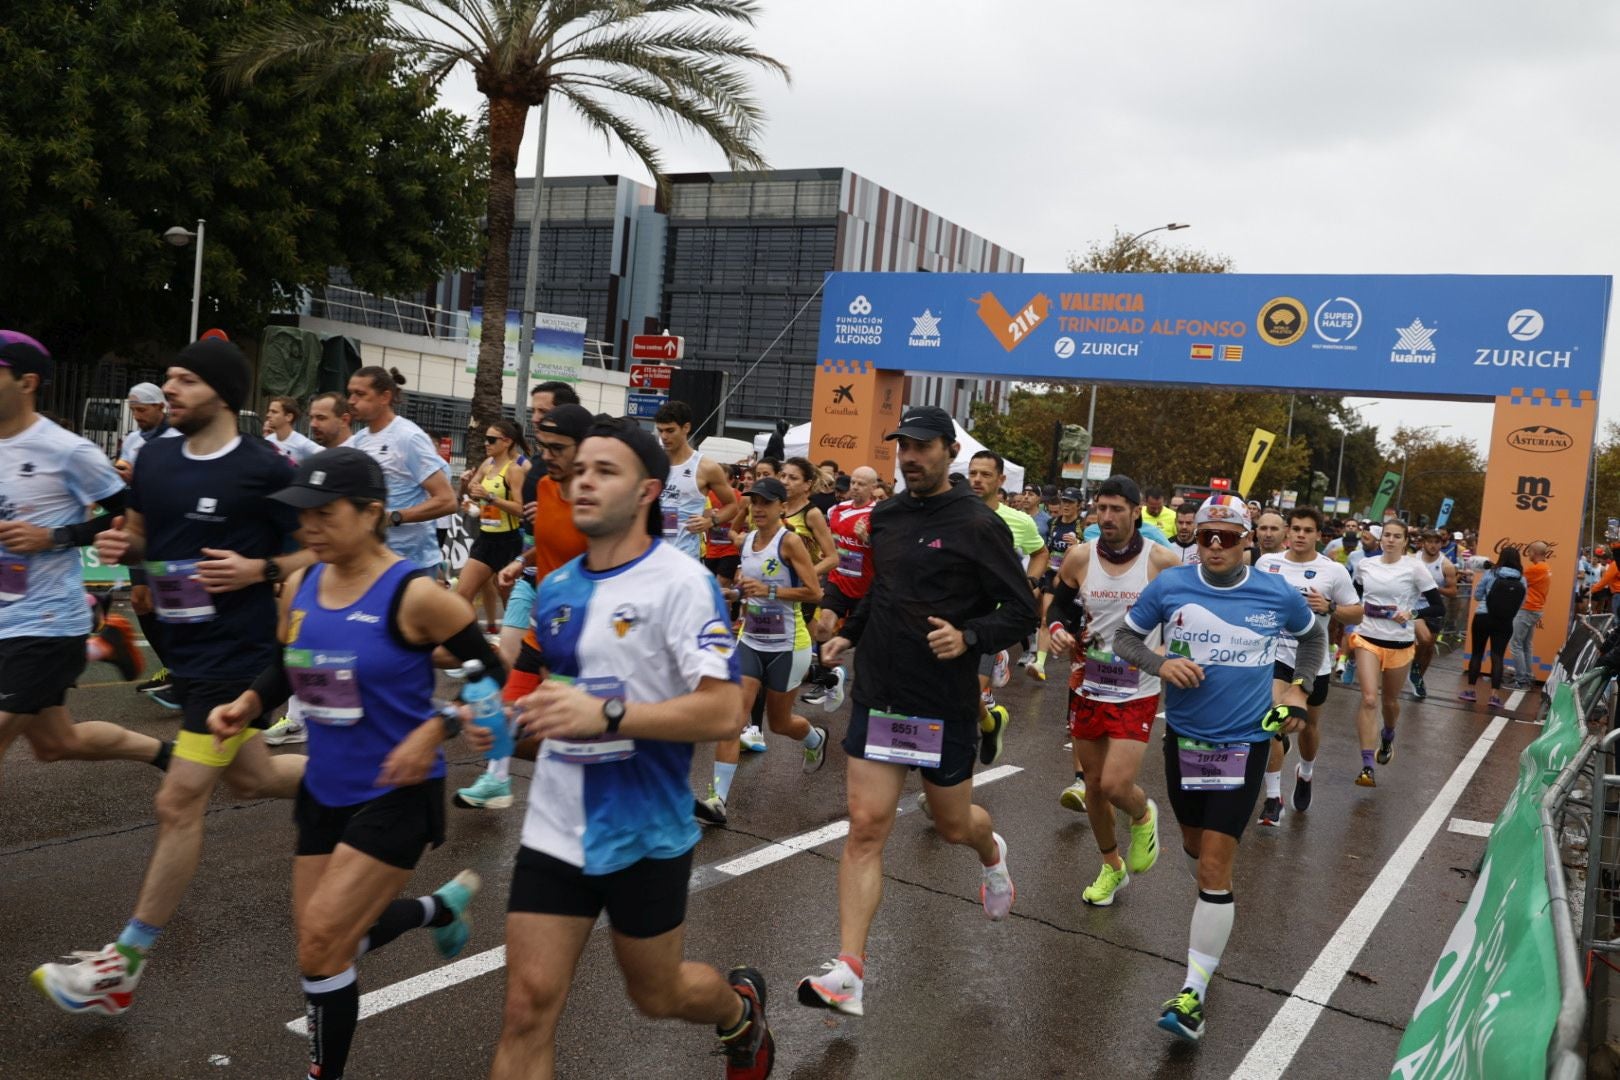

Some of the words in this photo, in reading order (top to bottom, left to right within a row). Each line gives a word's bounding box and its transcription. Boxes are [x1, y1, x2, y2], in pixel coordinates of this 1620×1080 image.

[1059, 293, 1145, 312] VALENCIA
[836, 316, 883, 324] FUNDACIÓN
[1323, 312, 1354, 320] SUPER
[836, 324, 882, 334] TRINIDAD
[1057, 316, 1146, 334] TRINIDAD
[1150, 319, 1247, 338] ALFONSO
[1322, 320, 1353, 328] HALFS
[834, 335, 882, 345] ALFONSO
[908, 336, 941, 347] luanvi
[1081, 342, 1139, 356] ZURICH
[1390, 351, 1436, 364] luanvi
[1473, 348, 1572, 368] ZURICH
[824, 406, 859, 416] CaixaBank
[1252, 439, 1269, 463] 1
[1380, 479, 1396, 496] 2
[1441, 503, 1452, 515] 3
[1090, 590, 1119, 599] MUÑOZ
[1209, 649, 1247, 663] 2016
[890, 722, 918, 735] 8551
